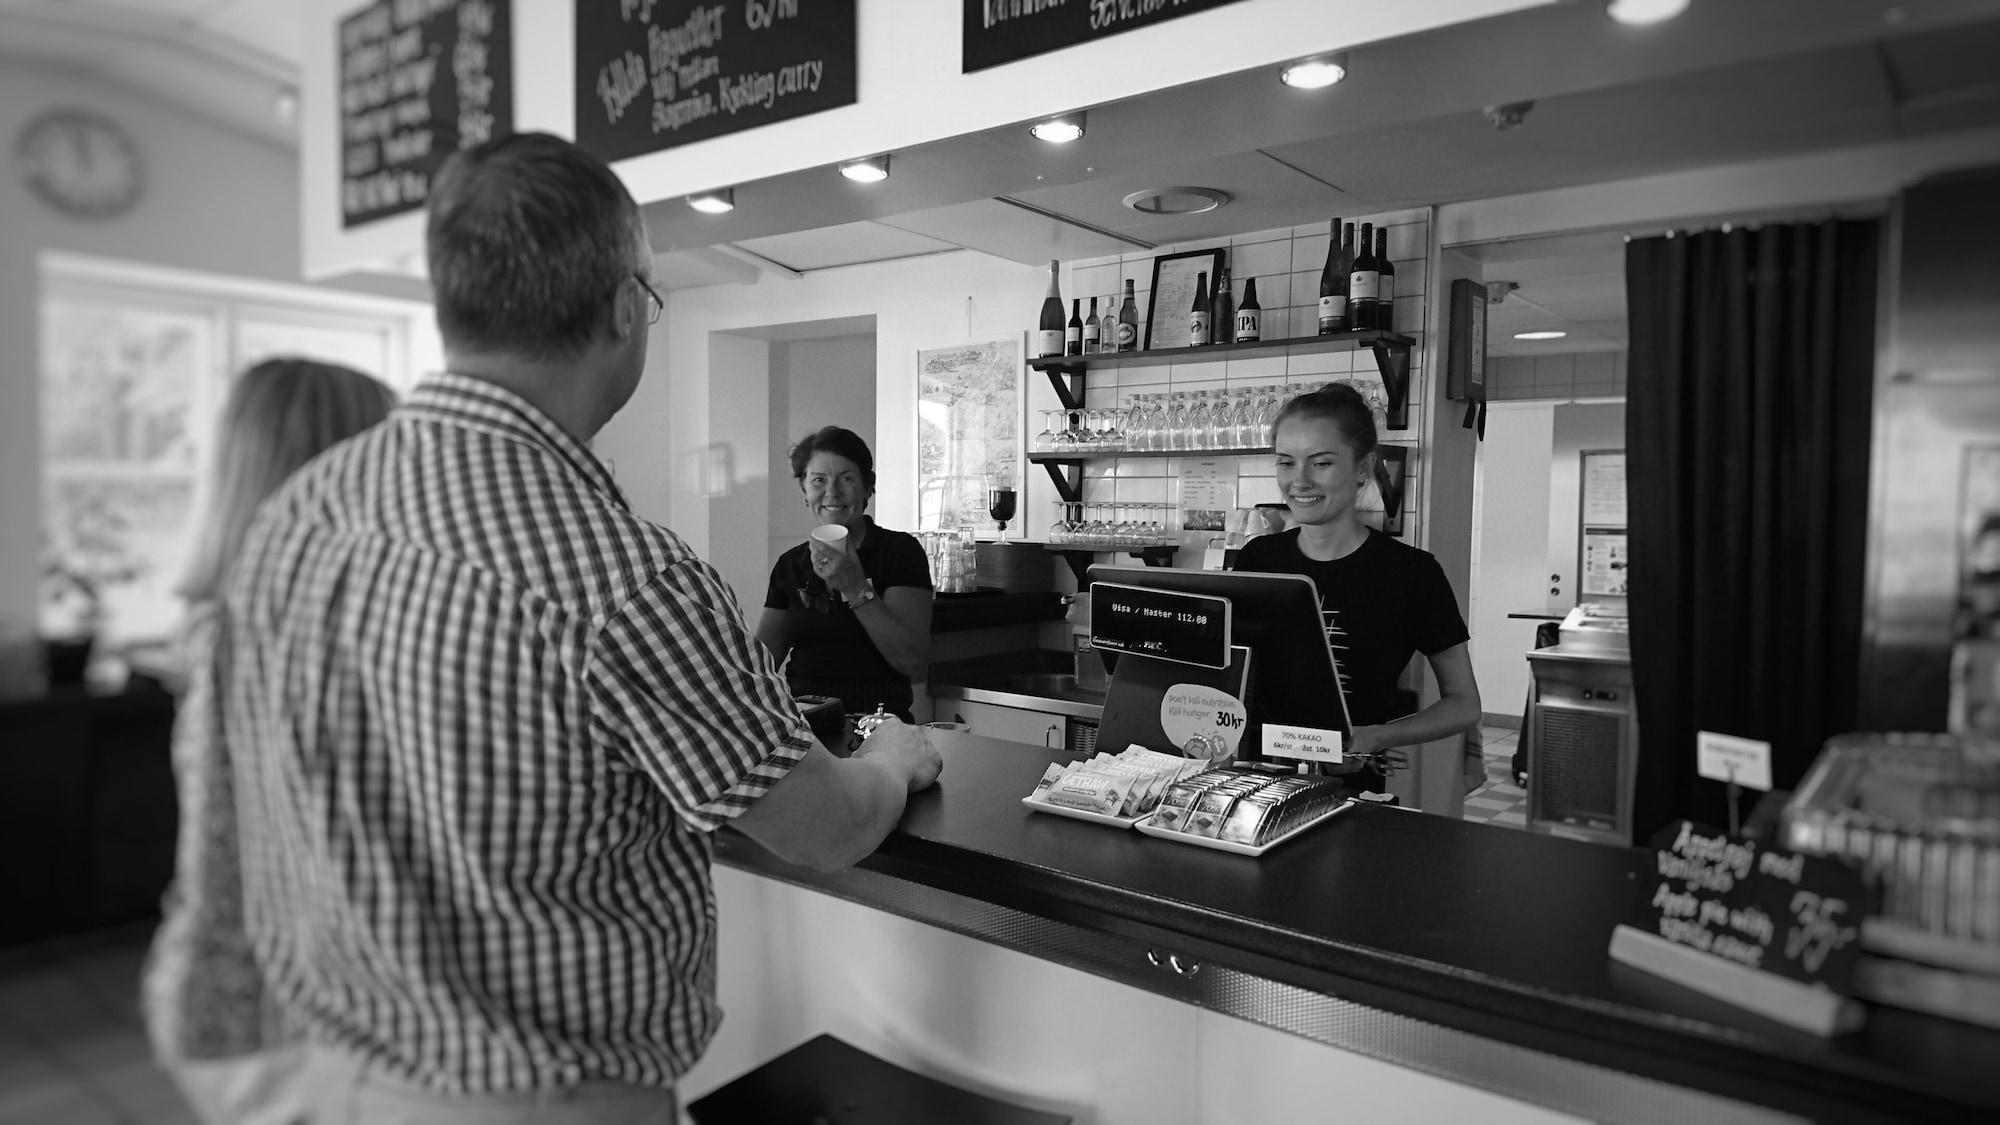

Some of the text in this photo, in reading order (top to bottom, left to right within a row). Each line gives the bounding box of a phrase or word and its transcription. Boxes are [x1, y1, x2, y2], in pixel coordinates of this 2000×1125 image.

[776, 59, 823, 97] curry
[1112, 603, 1131, 613] Visa
[1143, 608, 1172, 618] Master
[1298, 734, 1322, 743] KAKAO
